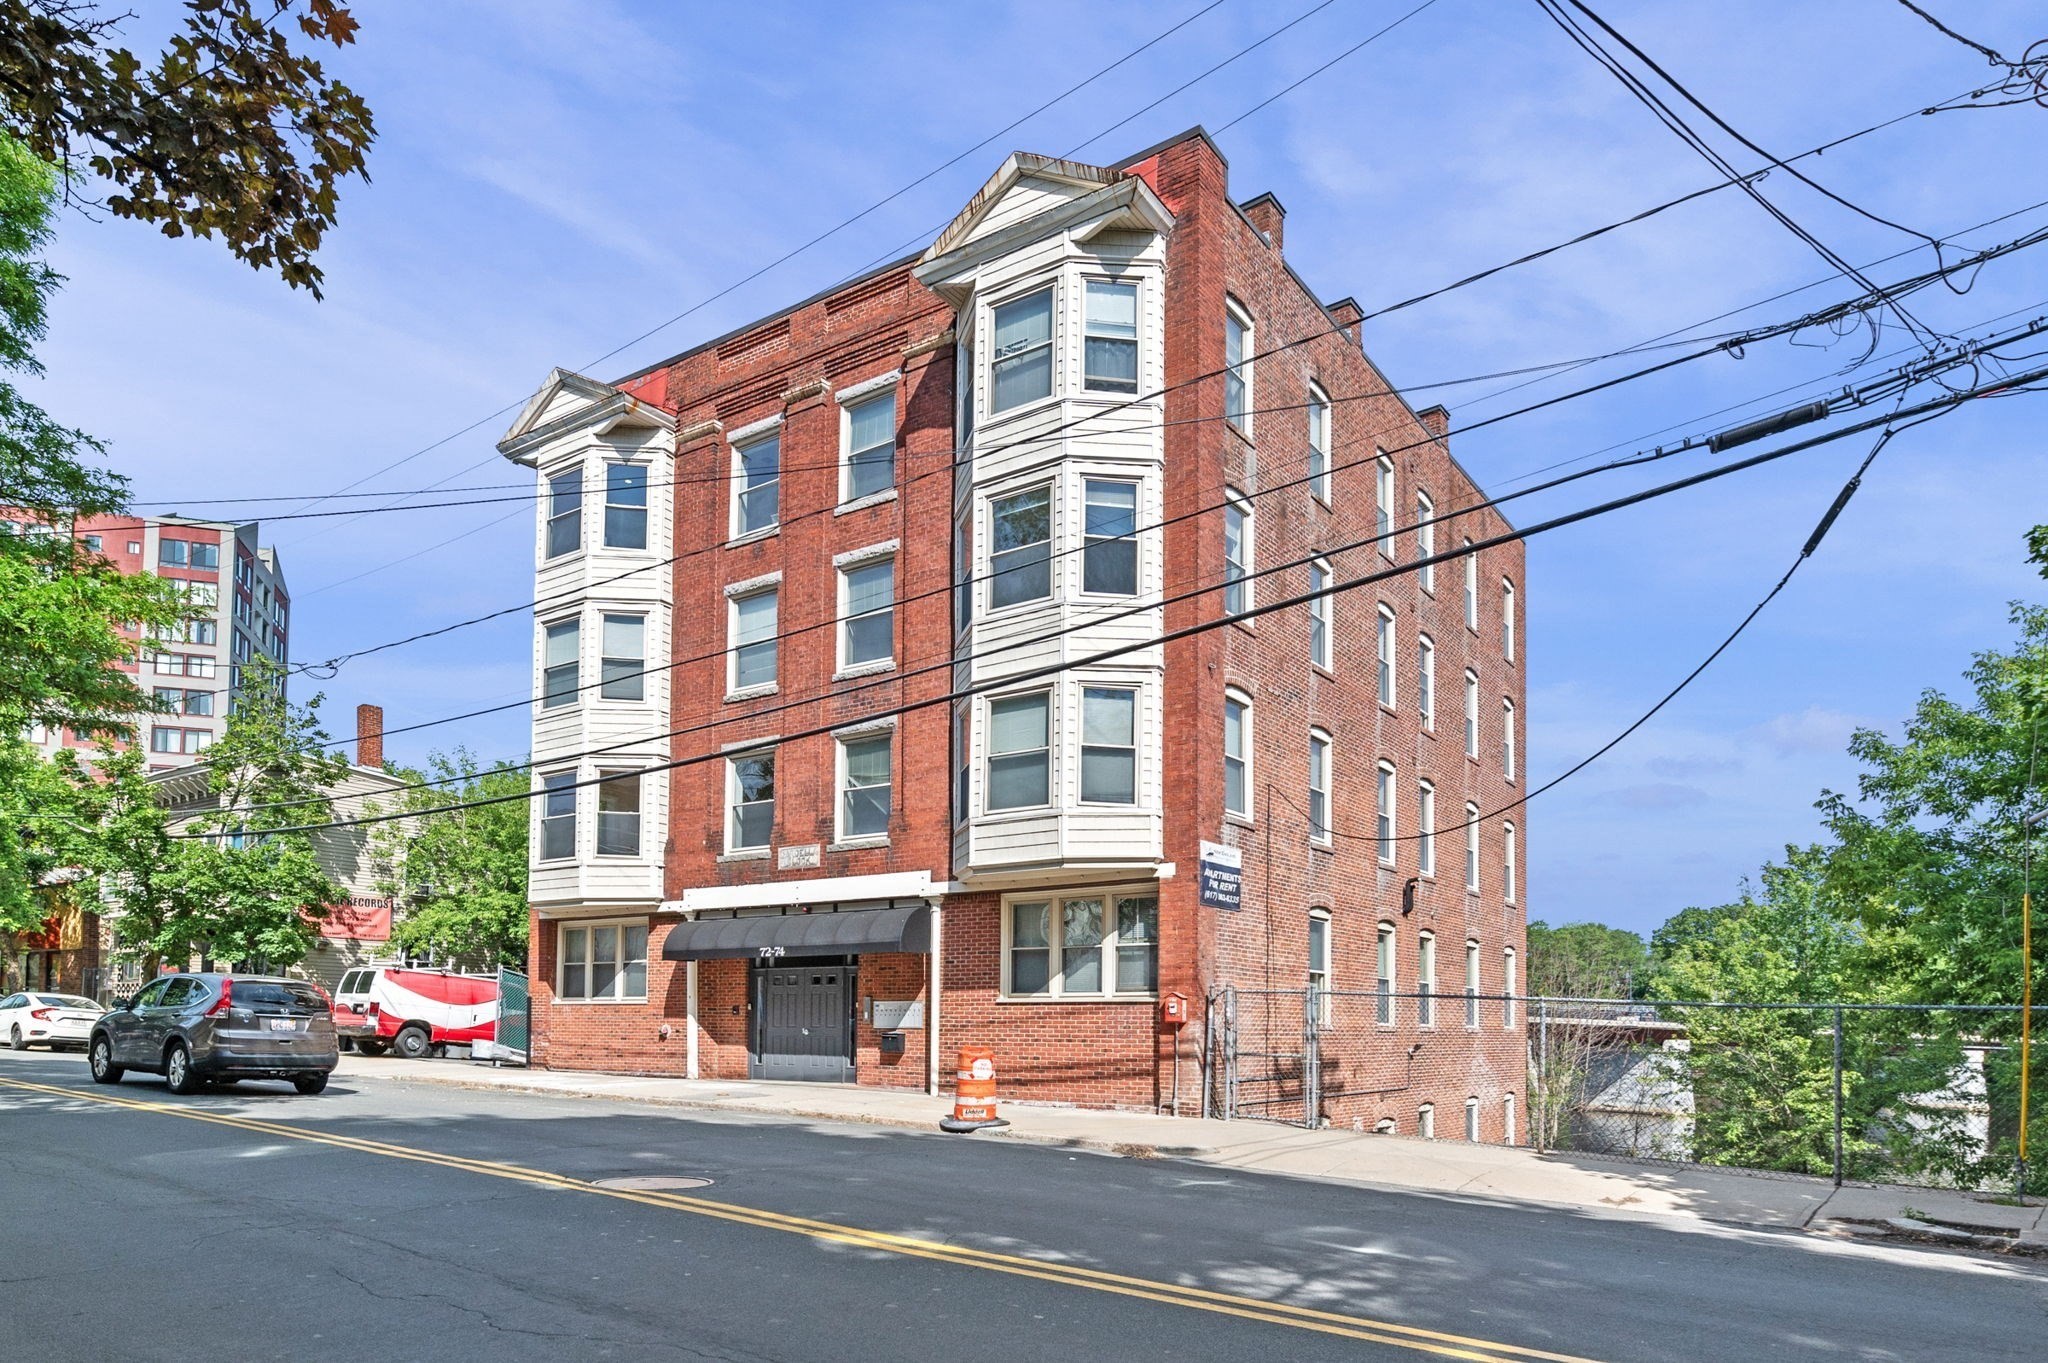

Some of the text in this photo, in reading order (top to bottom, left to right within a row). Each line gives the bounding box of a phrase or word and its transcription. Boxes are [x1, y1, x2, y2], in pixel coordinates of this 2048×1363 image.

[1203, 867, 1242, 883] APARTMENTS
[1208, 879, 1237, 892] FOR RENT
[349, 897, 389, 909] RECORDS
[760, 946, 785, 957] 72-74
